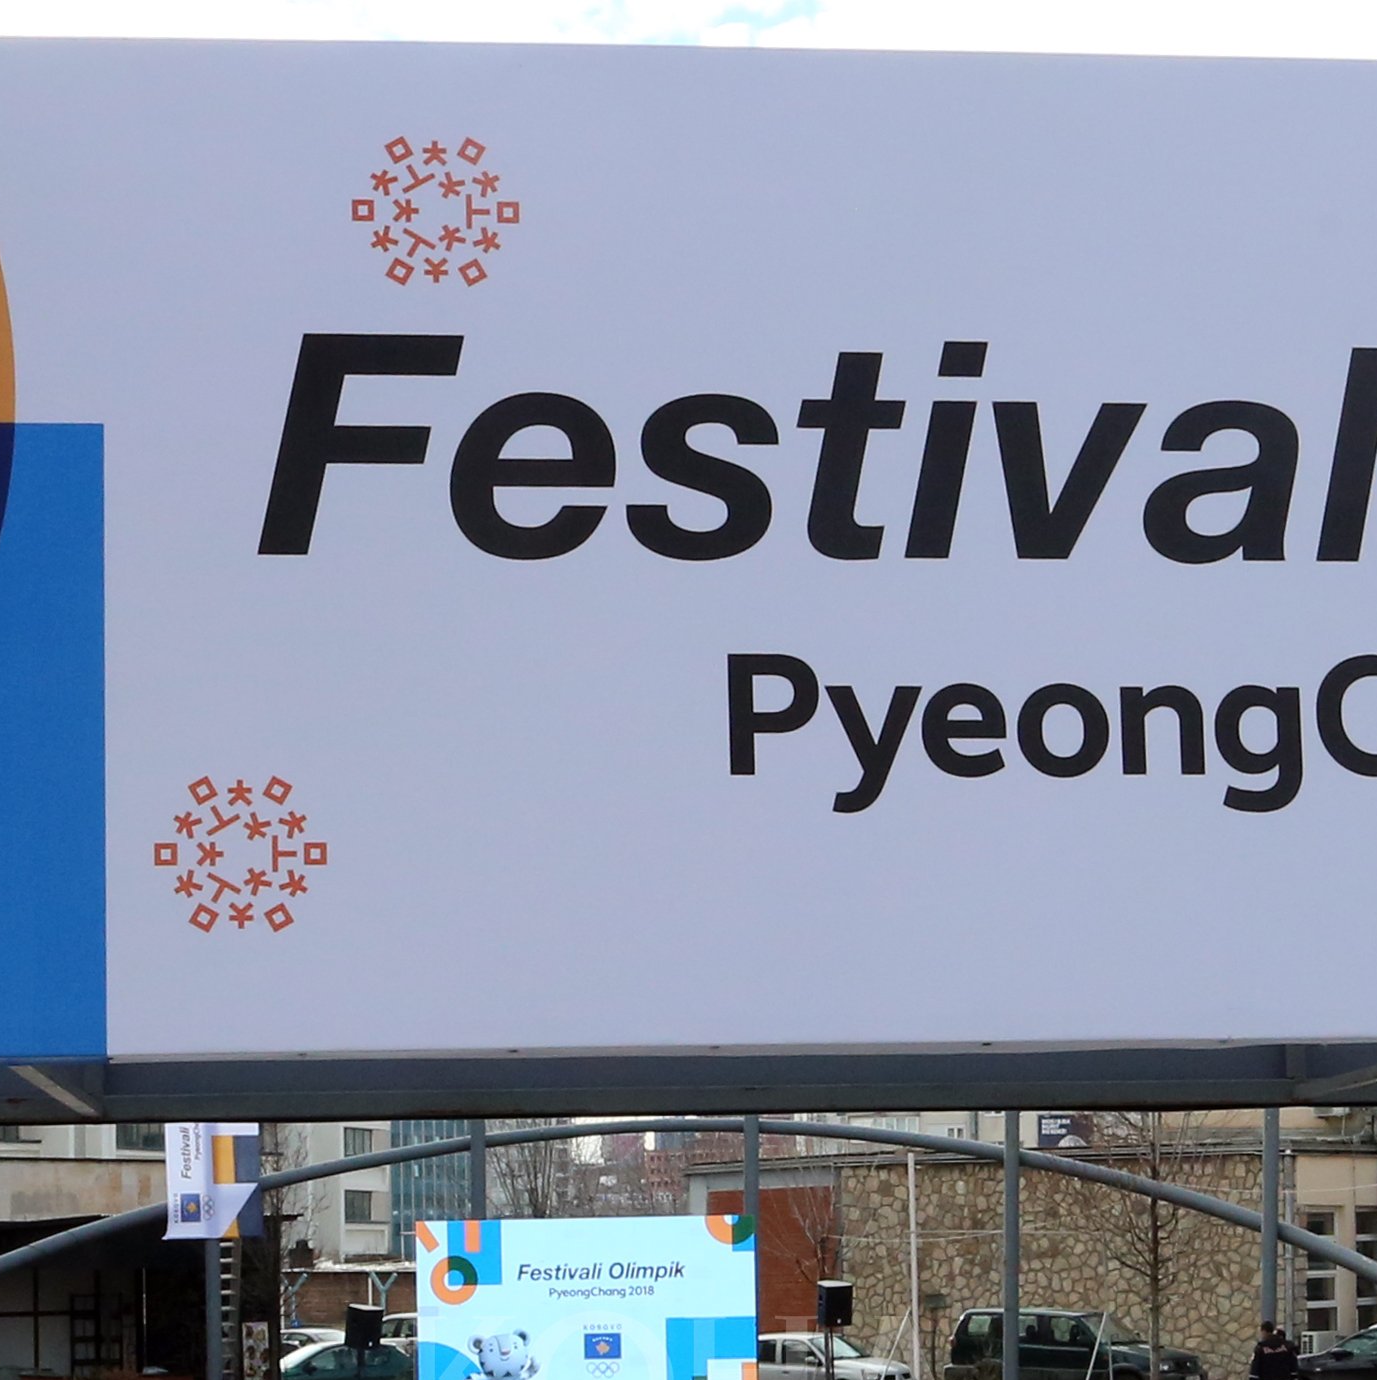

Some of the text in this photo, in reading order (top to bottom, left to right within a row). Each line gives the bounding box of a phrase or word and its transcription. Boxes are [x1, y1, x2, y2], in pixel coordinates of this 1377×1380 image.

[517, 1261, 685, 1282] Festivali Olimpik
[549, 1286, 654, 1299] PyeongChang 2018
